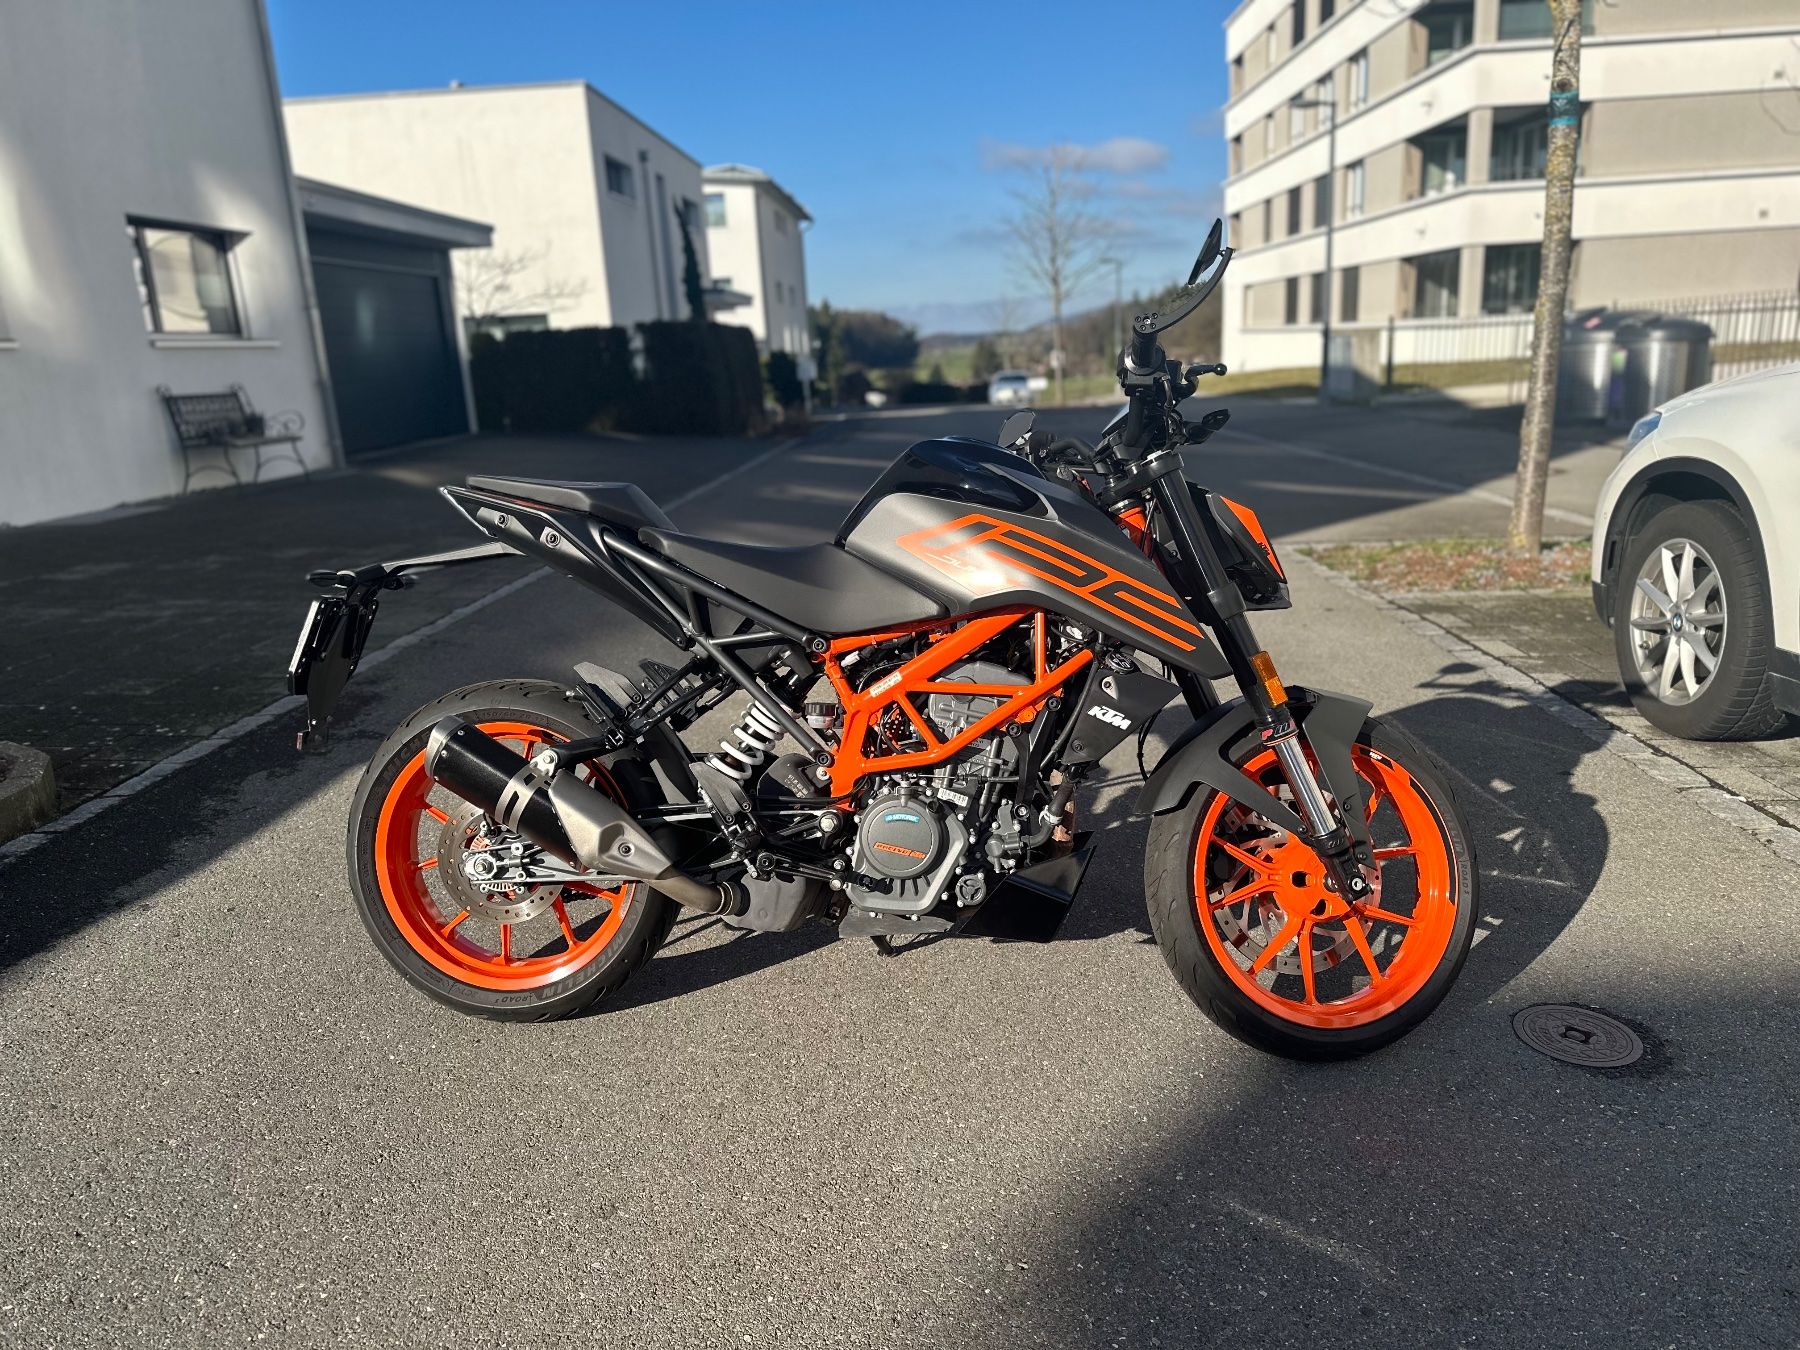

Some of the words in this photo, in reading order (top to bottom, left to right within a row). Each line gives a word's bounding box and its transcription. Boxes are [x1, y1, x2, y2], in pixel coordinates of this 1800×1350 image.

[1087, 705, 1132, 730] KTM
[1460, 864, 1469, 890] ROAD
[541, 933, 624, 998] MICHELIN
[502, 995, 528, 1003] ROAD
